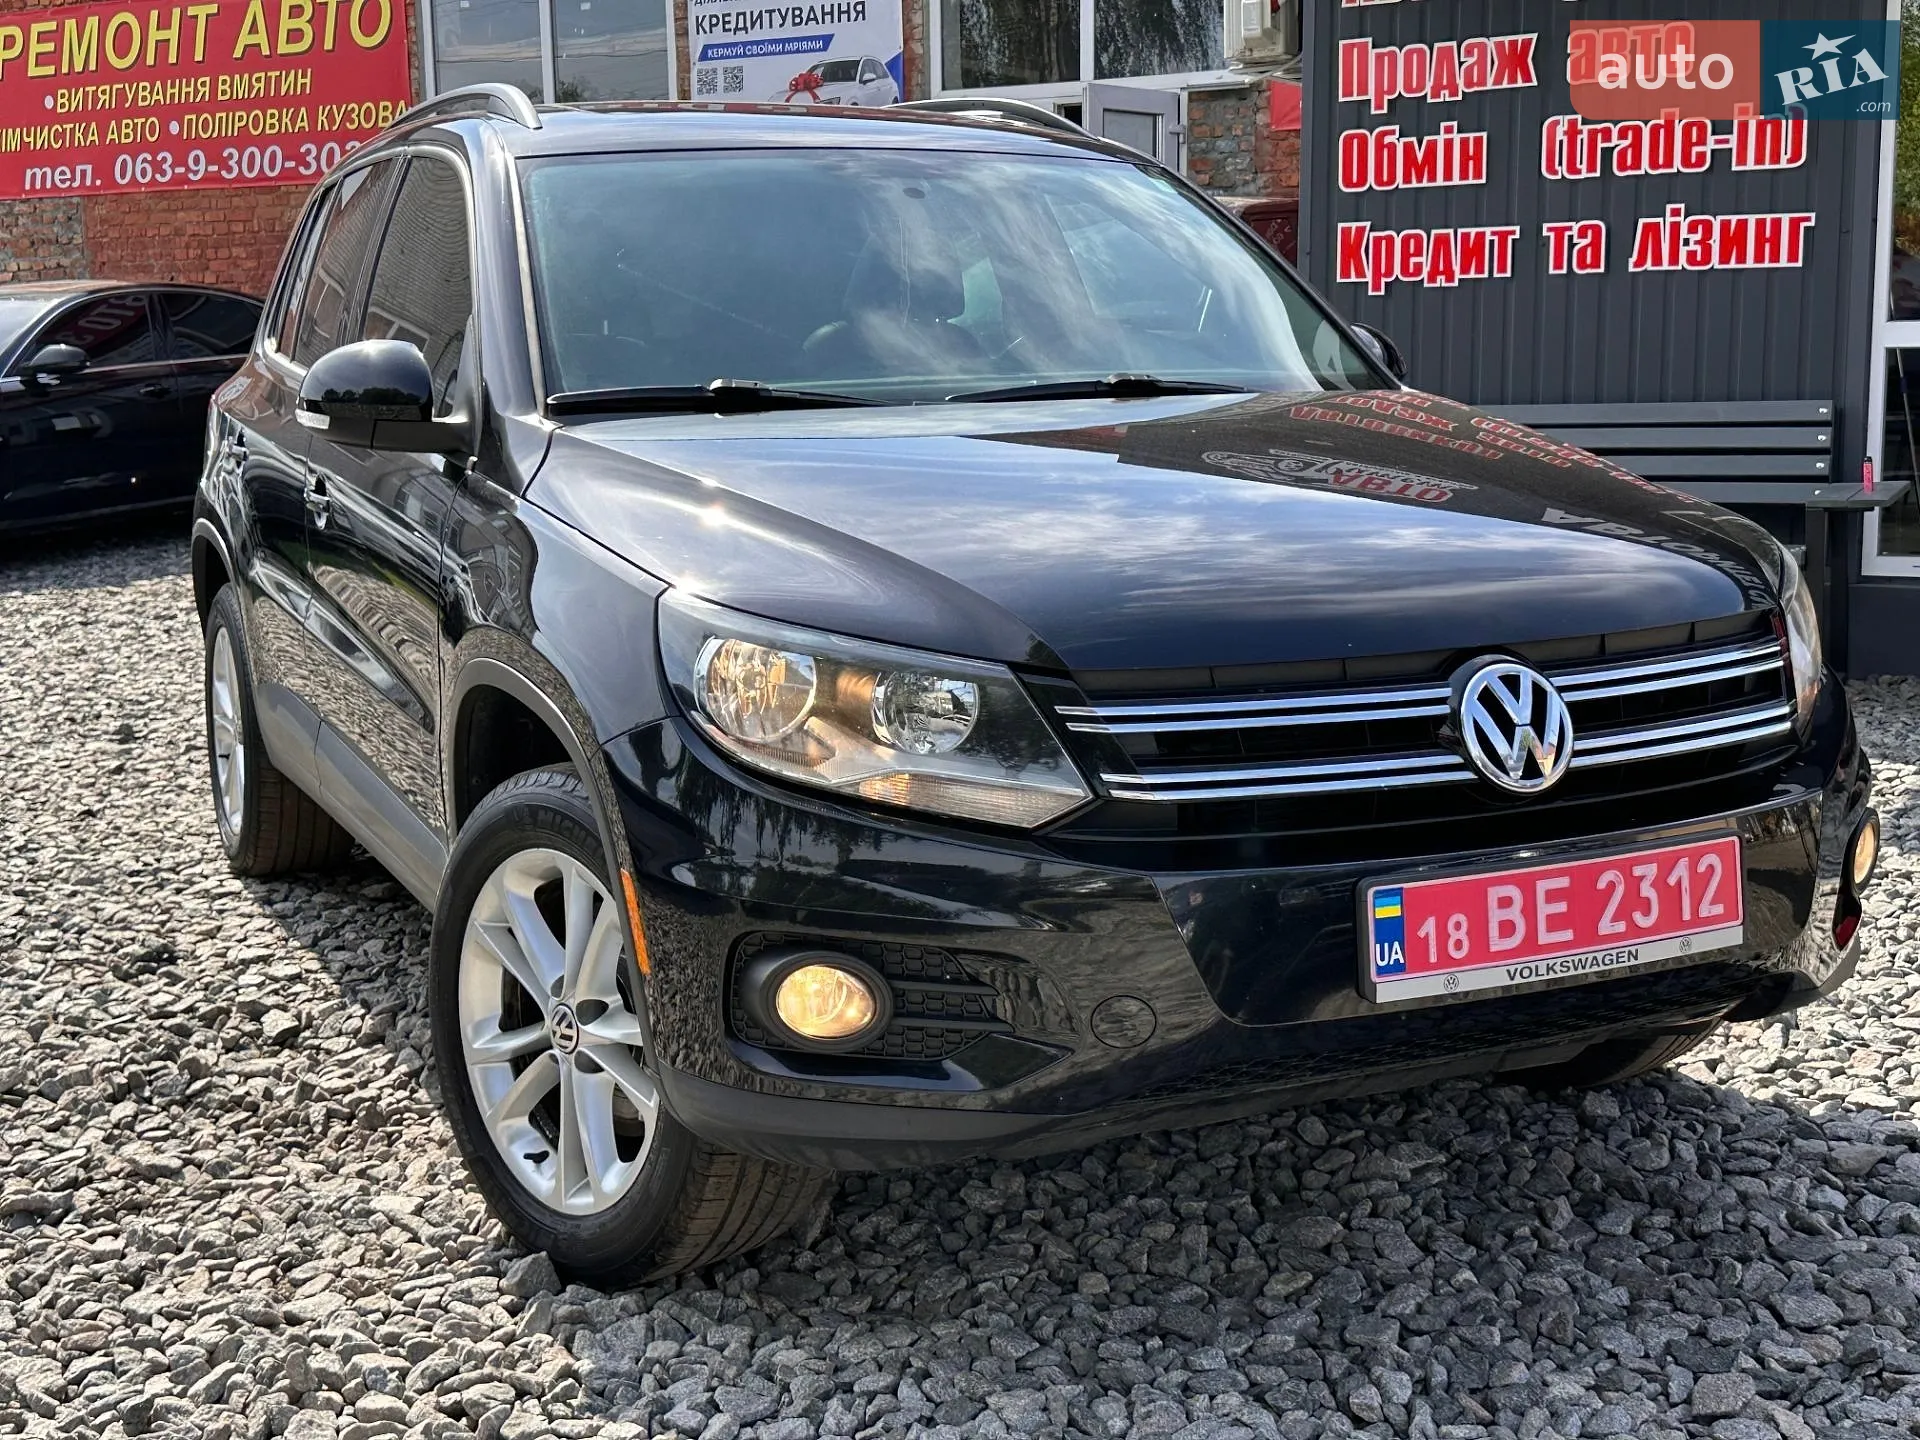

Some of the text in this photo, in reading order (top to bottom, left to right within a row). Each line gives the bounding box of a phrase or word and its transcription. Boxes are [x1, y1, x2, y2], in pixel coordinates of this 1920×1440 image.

[0, 0, 391, 80] РЕМОНТ АВТО
[695, 1, 866, 36] КРЕДИТУВАННЯ
[707, 40, 823, 58] КЕРМУЙ СВОЇМИ МРІЯМИ
[1338, 32, 1539, 114] Продаж
[56, 68, 312, 114] ВИТЯГУВАННЯ ВМЯТИН
[0, 116, 160, 153] ІМЧИСТКА АВТО
[183, 106, 309, 140] ПОЛІРОВКА
[1541, 102, 1808, 180] (trade-in)
[1338, 120, 1488, 193] Обмін
[1336, 220, 1520, 296] Кредит
[1542, 220, 1605, 275] та
[1628, 203, 1815, 272] лізинг
[1375, 853, 1724, 967] UA 18 BE 2312
[1506, 948, 1640, 982] VOLKSWAGEN
